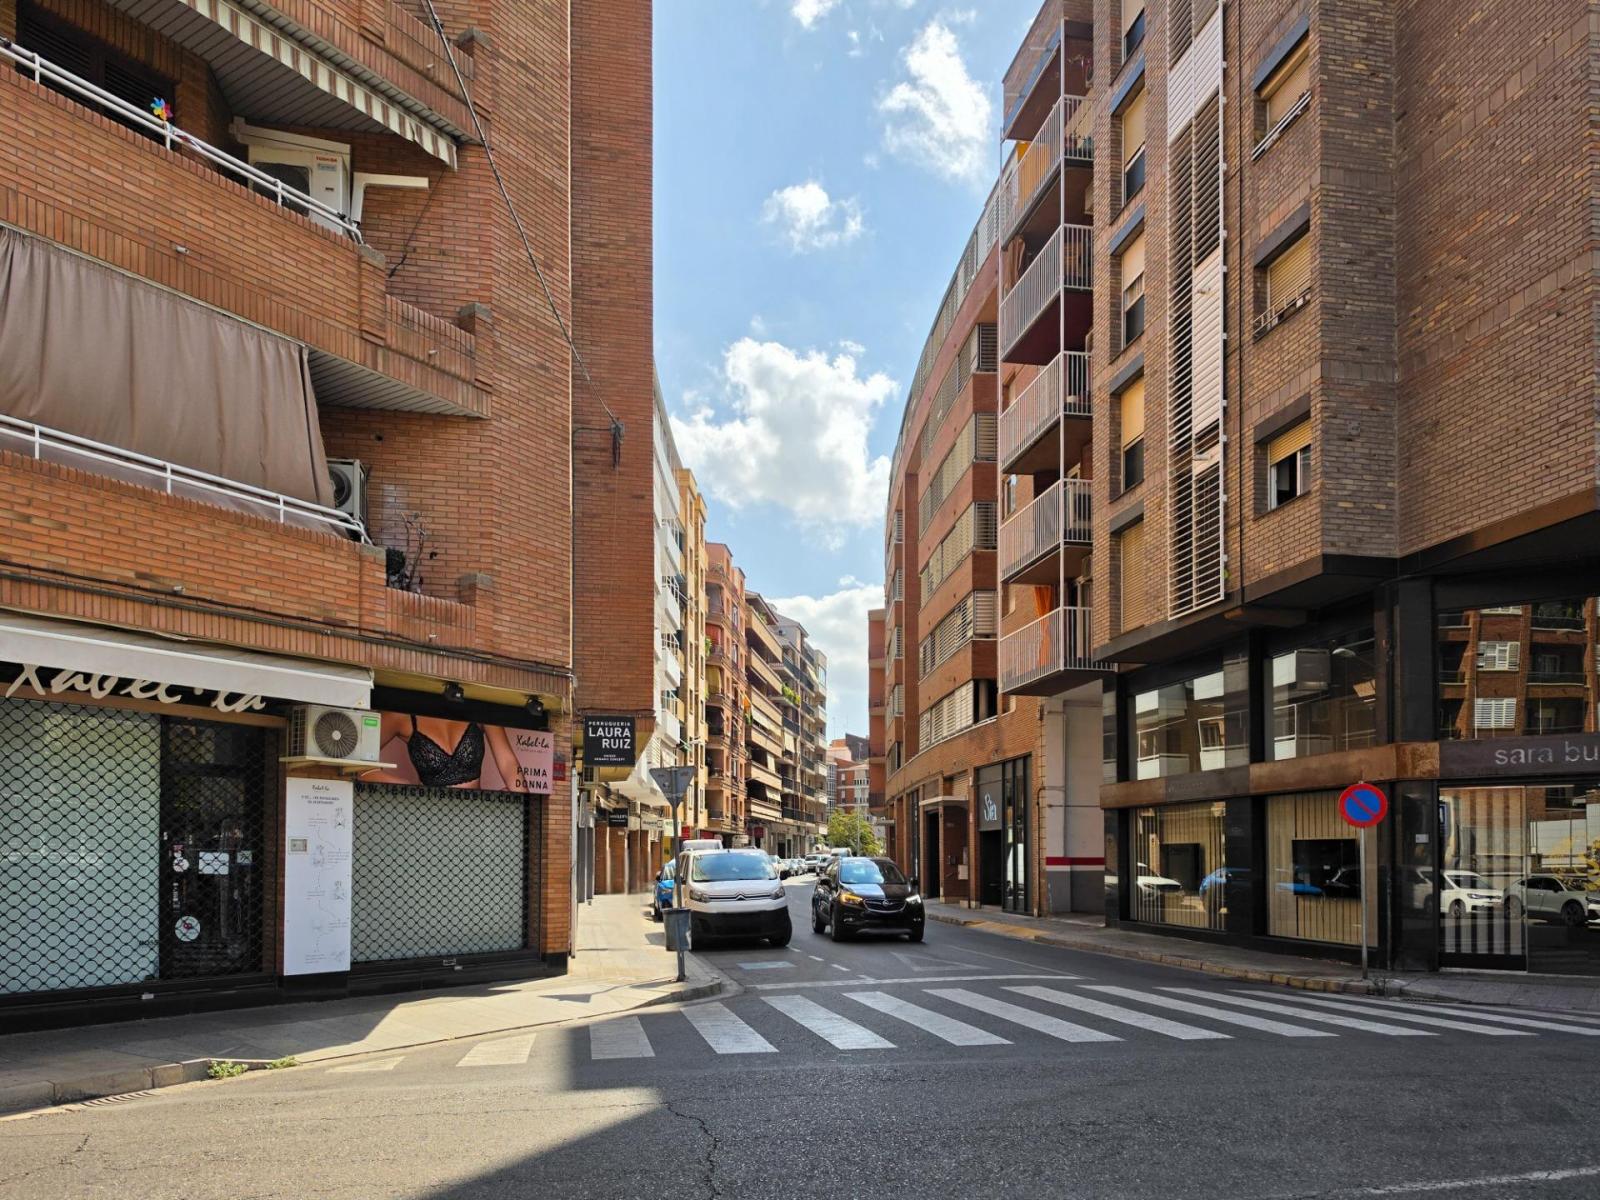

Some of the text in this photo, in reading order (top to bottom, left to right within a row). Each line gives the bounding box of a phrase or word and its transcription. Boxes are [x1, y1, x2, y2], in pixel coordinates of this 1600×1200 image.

[588, 727, 631, 738] LAURA
[602, 738, 631, 749] RUIZ
[1494, 741, 1599, 765] sara bu
[516, 766, 548, 777] PRIMA
[515, 779, 548, 790] DONNA
